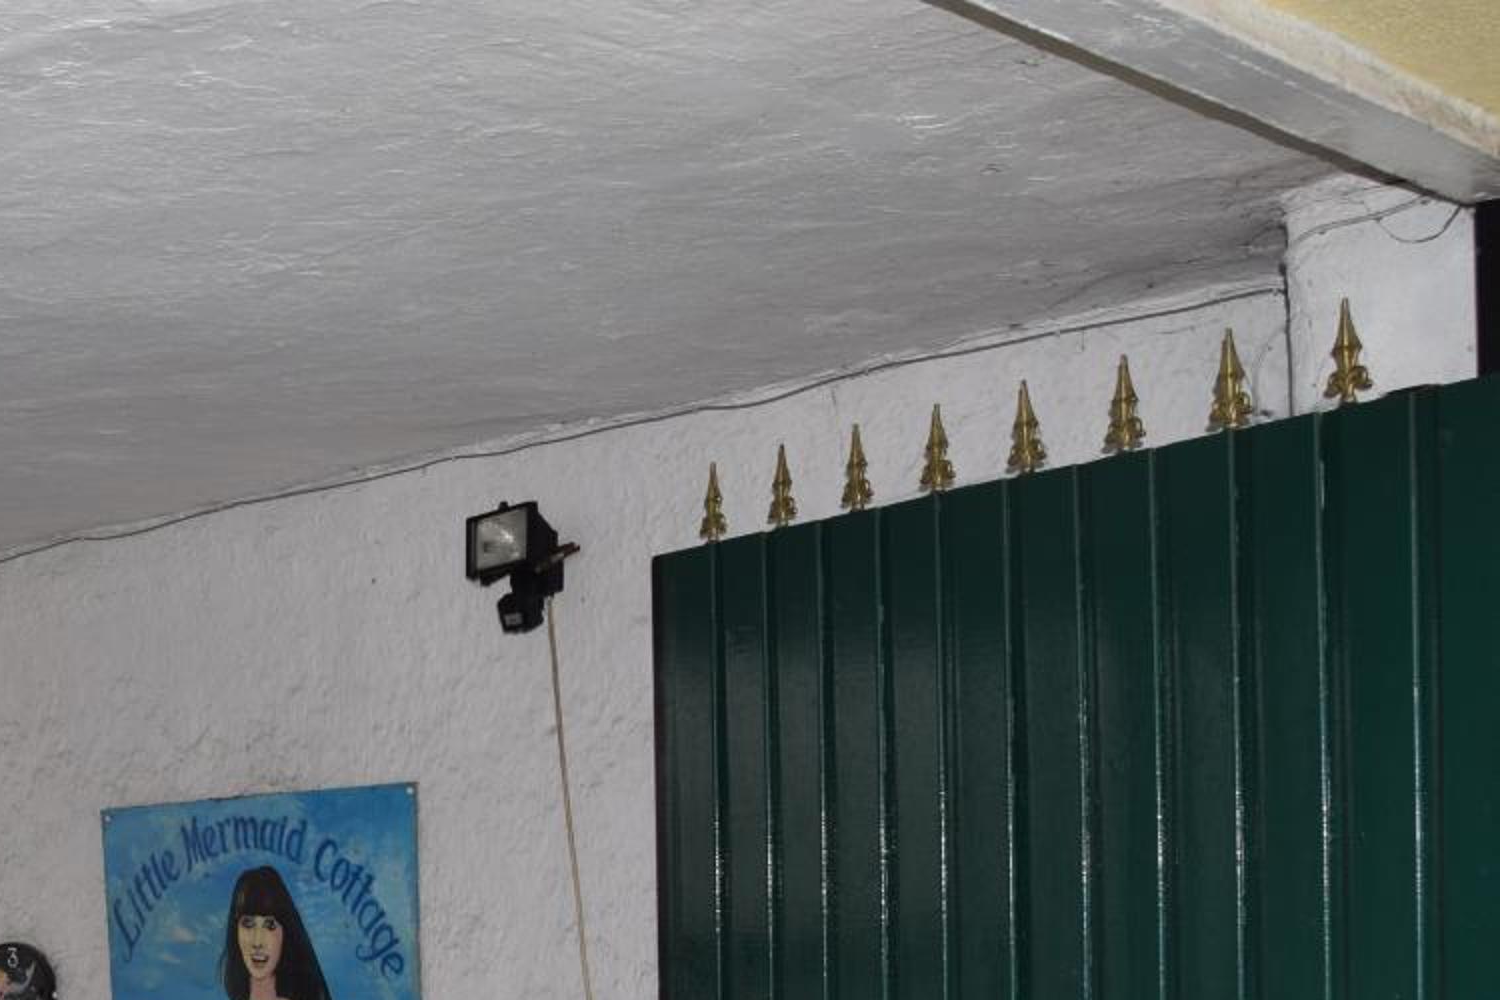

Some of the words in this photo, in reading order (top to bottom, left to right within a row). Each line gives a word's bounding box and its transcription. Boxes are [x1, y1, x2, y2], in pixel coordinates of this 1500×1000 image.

[113, 849, 181, 963] Little
[180, 814, 308, 872] Mermaid
[313, 838, 405, 977] Cottage
[7, 946, 19, 969] 3
